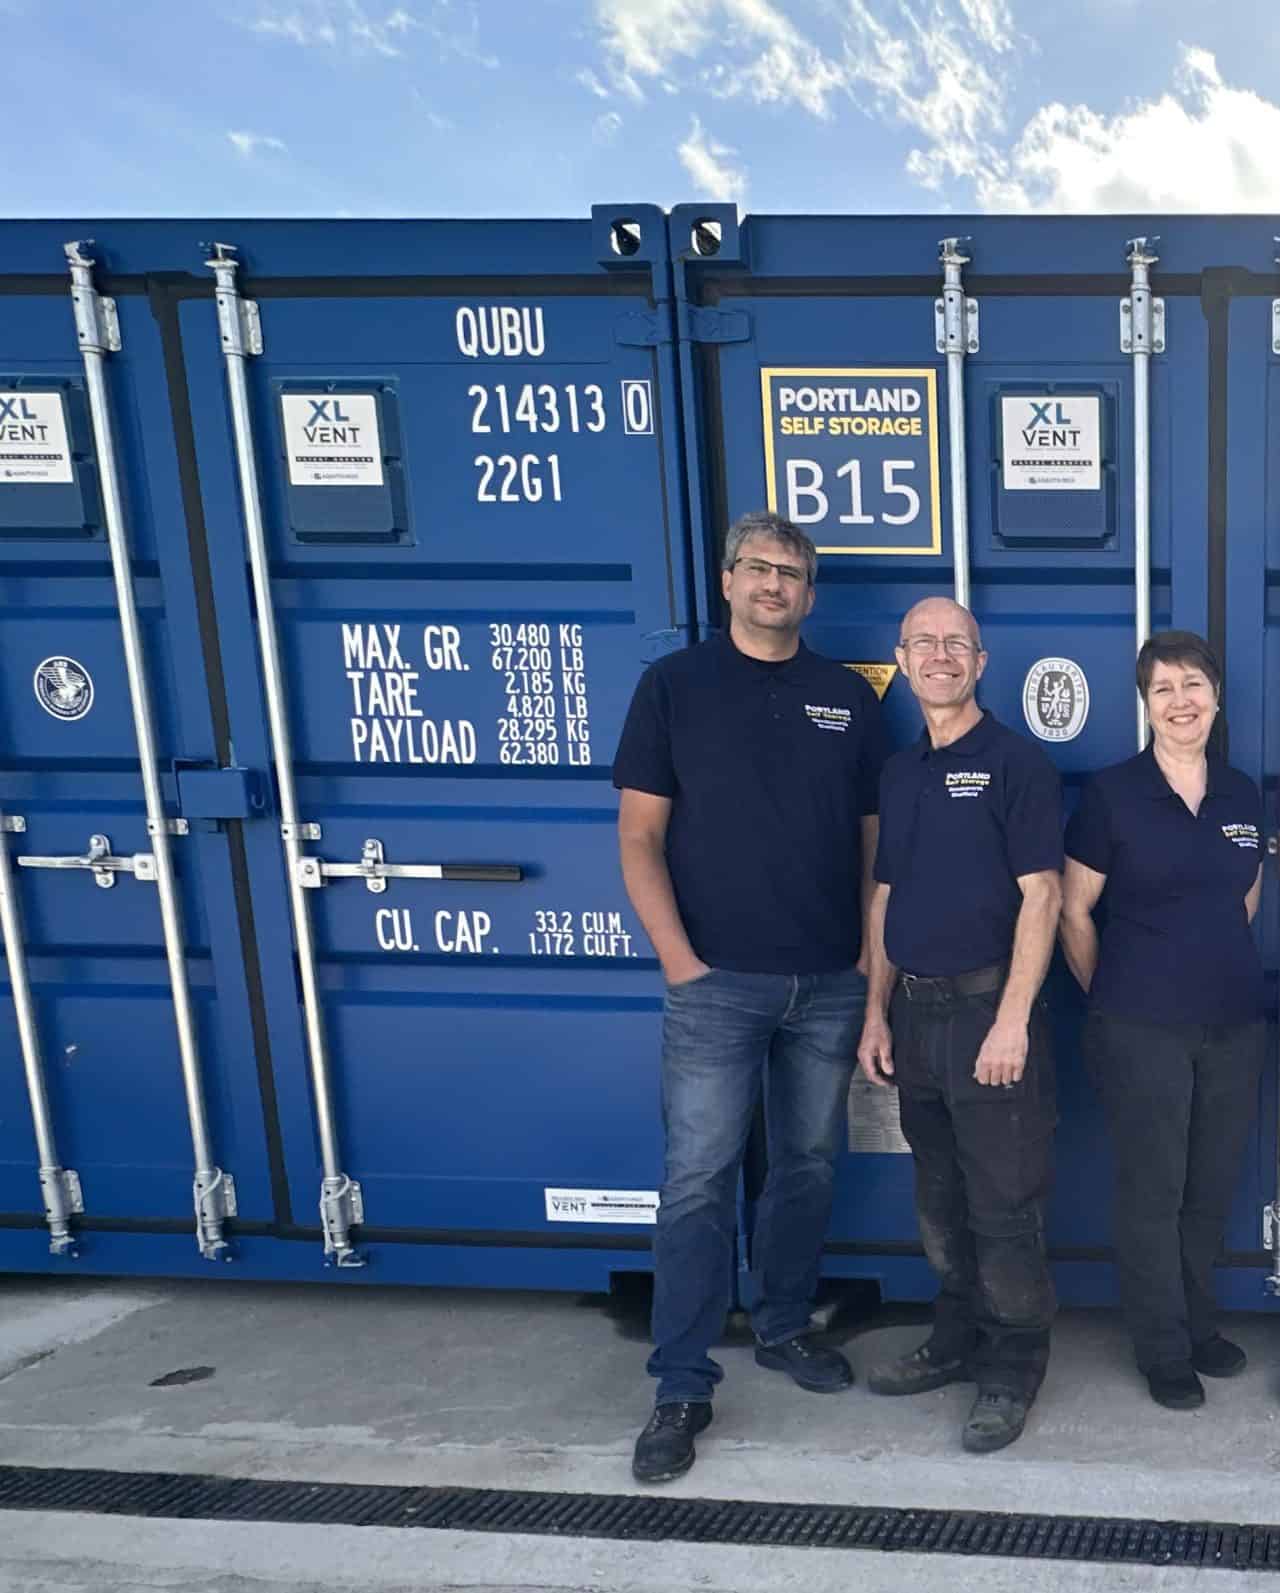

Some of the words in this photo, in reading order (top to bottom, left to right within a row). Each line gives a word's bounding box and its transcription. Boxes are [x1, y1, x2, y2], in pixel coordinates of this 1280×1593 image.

[456, 306, 545, 357] QUBU
[468, 384, 605, 433] 214313
[627, 384, 649, 431] 0
[779, 387, 921, 412] PORTLAND
[307, 400, 349, 427] XL
[1027, 403, 1071, 430] XL
[303, 427, 360, 443] VENT
[780, 417, 824, 435] SELF
[829, 417, 922, 435] STORAGE
[1022, 430, 1080, 446] VENT
[474, 454, 562, 502] 22G1
[786, 459, 920, 525] B15
[342, 624, 411, 670] MAX.
[424, 626, 470, 670] GR.
[560, 624, 583, 647] KG
[561, 648, 584, 671] LB
[346, 672, 423, 716] TARE
[563, 672, 586, 695] KG
[565, 696, 588, 719] LB
[351, 719, 476, 763] PAYLOAD
[567, 719, 590, 742] KG
[568, 743, 591, 766] LB
[376, 909, 420, 950] CU.
[435, 910, 500, 953] CAP.
[535, 910, 573, 933] 33.2
[582, 912, 626, 934] CU.M.
[583, 934, 638, 957] CU.FT.
[552, 1201, 587, 1213] VENT
